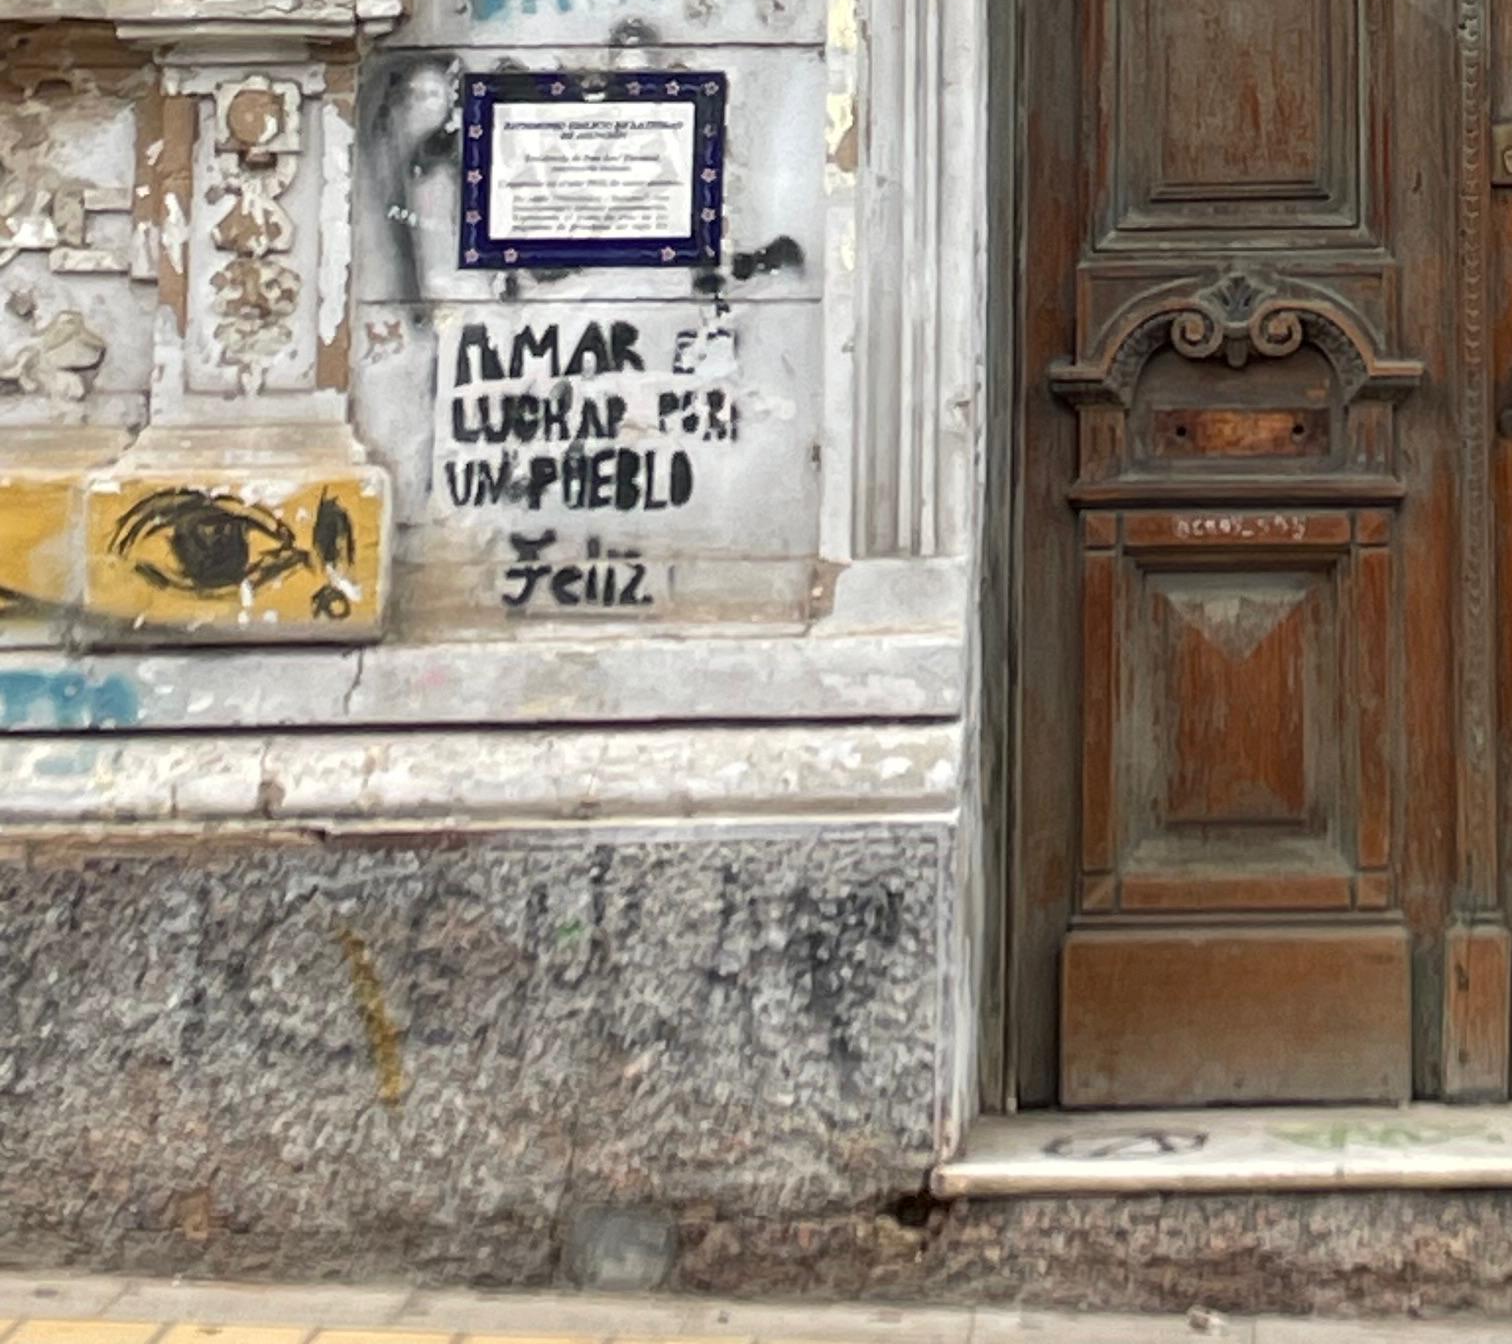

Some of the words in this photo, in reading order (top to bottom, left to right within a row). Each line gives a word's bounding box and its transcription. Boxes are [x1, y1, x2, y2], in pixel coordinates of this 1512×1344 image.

[454, 321, 646, 387] AMAR
[440, 460, 507, 506] UN
[528, 447, 693, 510] PUEBLO
